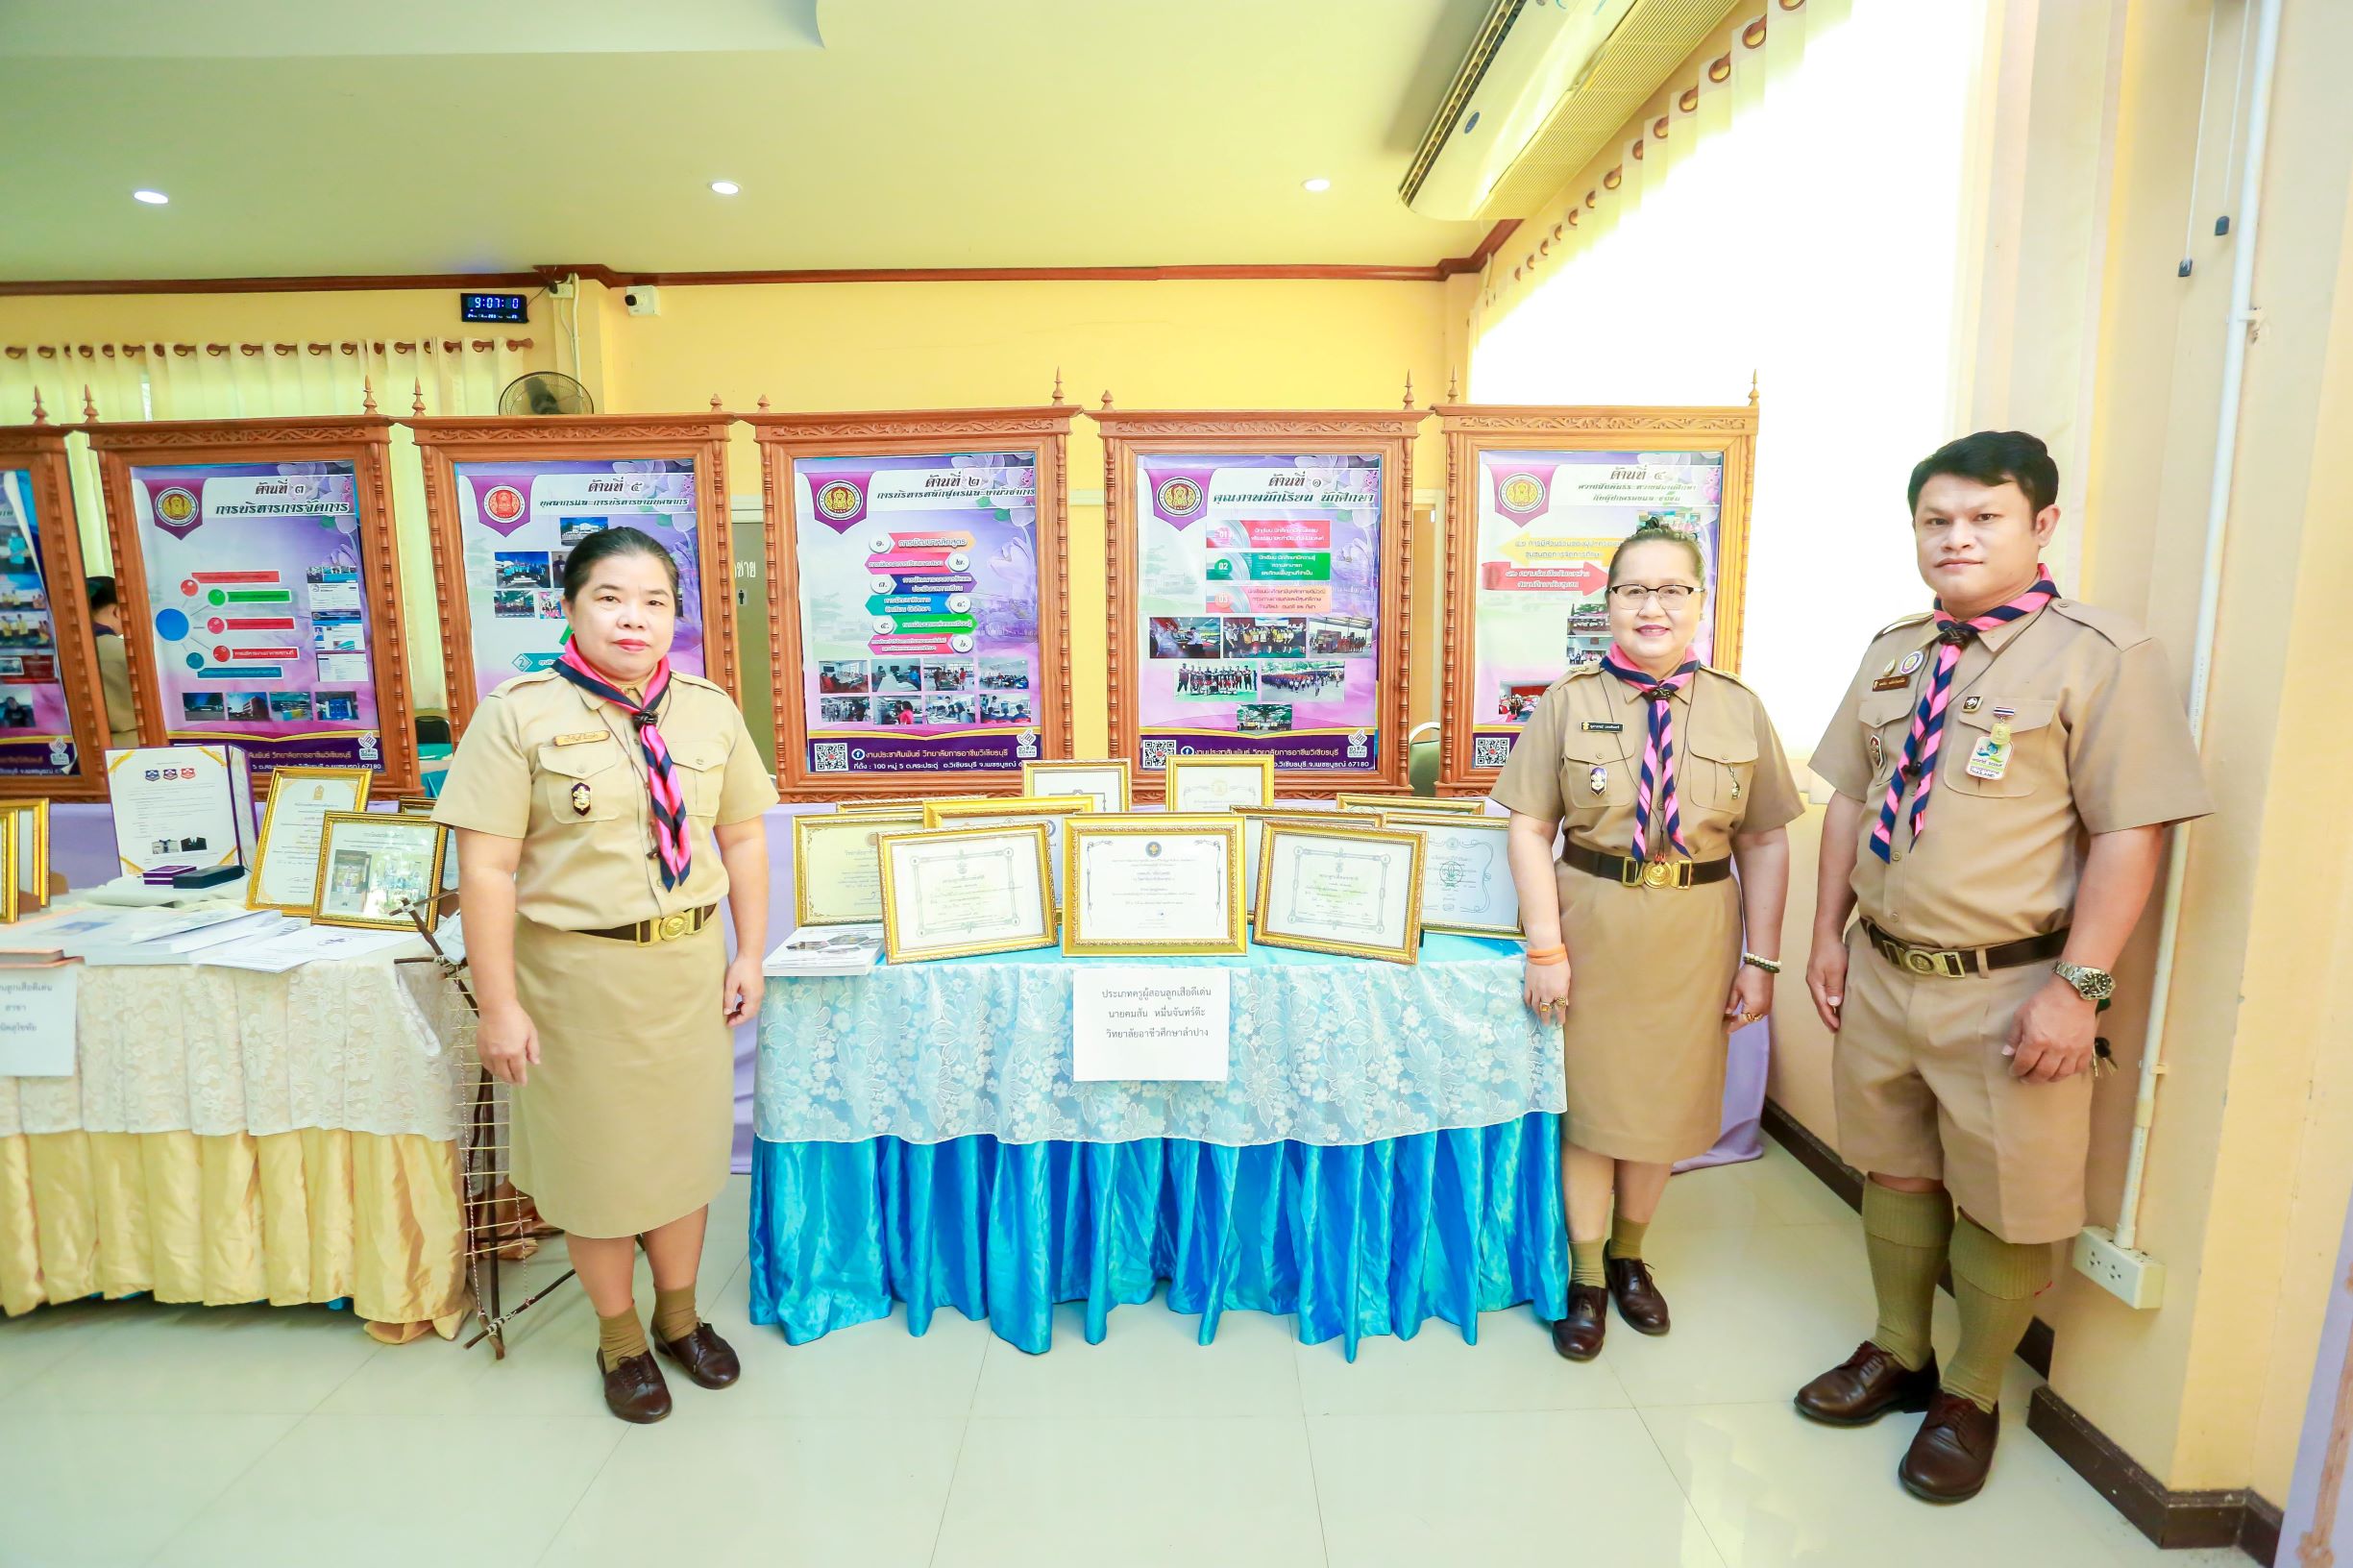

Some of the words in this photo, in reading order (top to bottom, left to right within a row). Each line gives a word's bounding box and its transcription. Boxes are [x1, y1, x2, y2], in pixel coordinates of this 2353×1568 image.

[1268, 471, 1305, 486] ด้านที่
[1610, 465, 1648, 479] ด้านที่
[255, 478, 287, 495] ด้านที่
[588, 477, 624, 492] ด้านที่
[925, 472, 961, 487] ด้านที่
[1213, 491, 1313, 504] คุณภาพนักเรียน
[1320, 491, 1374, 502] นักศึกษา
[215, 500, 349, 514] การบริหารการจัดการ
[866, 750, 920, 759] งานประชาสัมพันธ์
[1102, 986, 1212, 1000] ประเภทครูผู้สอนลูกเสือดีเด่น
[1106, 1027, 1209, 1039] วิทยาลัยอาชีวศึกษาลำปาง
